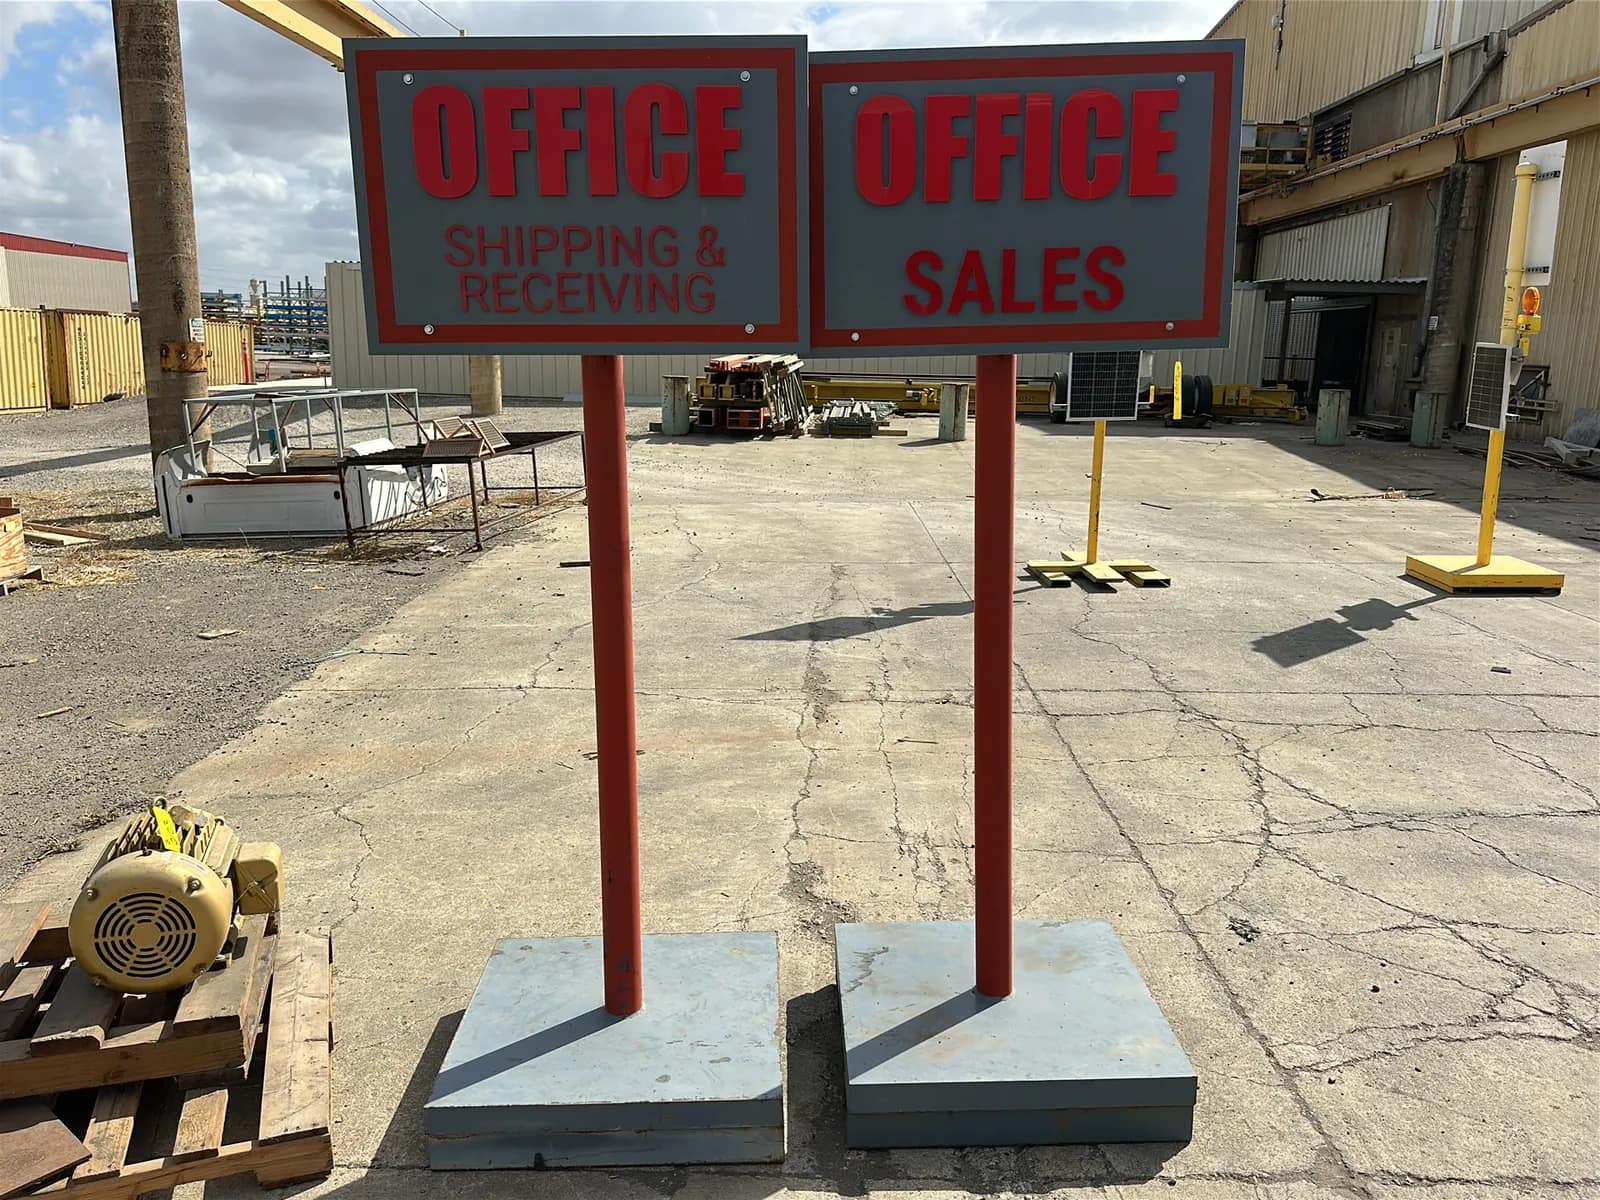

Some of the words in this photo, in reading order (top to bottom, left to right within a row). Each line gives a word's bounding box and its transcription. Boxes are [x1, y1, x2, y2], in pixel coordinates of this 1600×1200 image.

[412, 85, 745, 198] OFFICE
[856, 89, 1179, 206] OFFICE
[446, 226, 679, 267] SHIPPING
[696, 225, 726, 267] &
[903, 246, 1126, 316] SALES
[459, 272, 716, 314] RECEIVING
